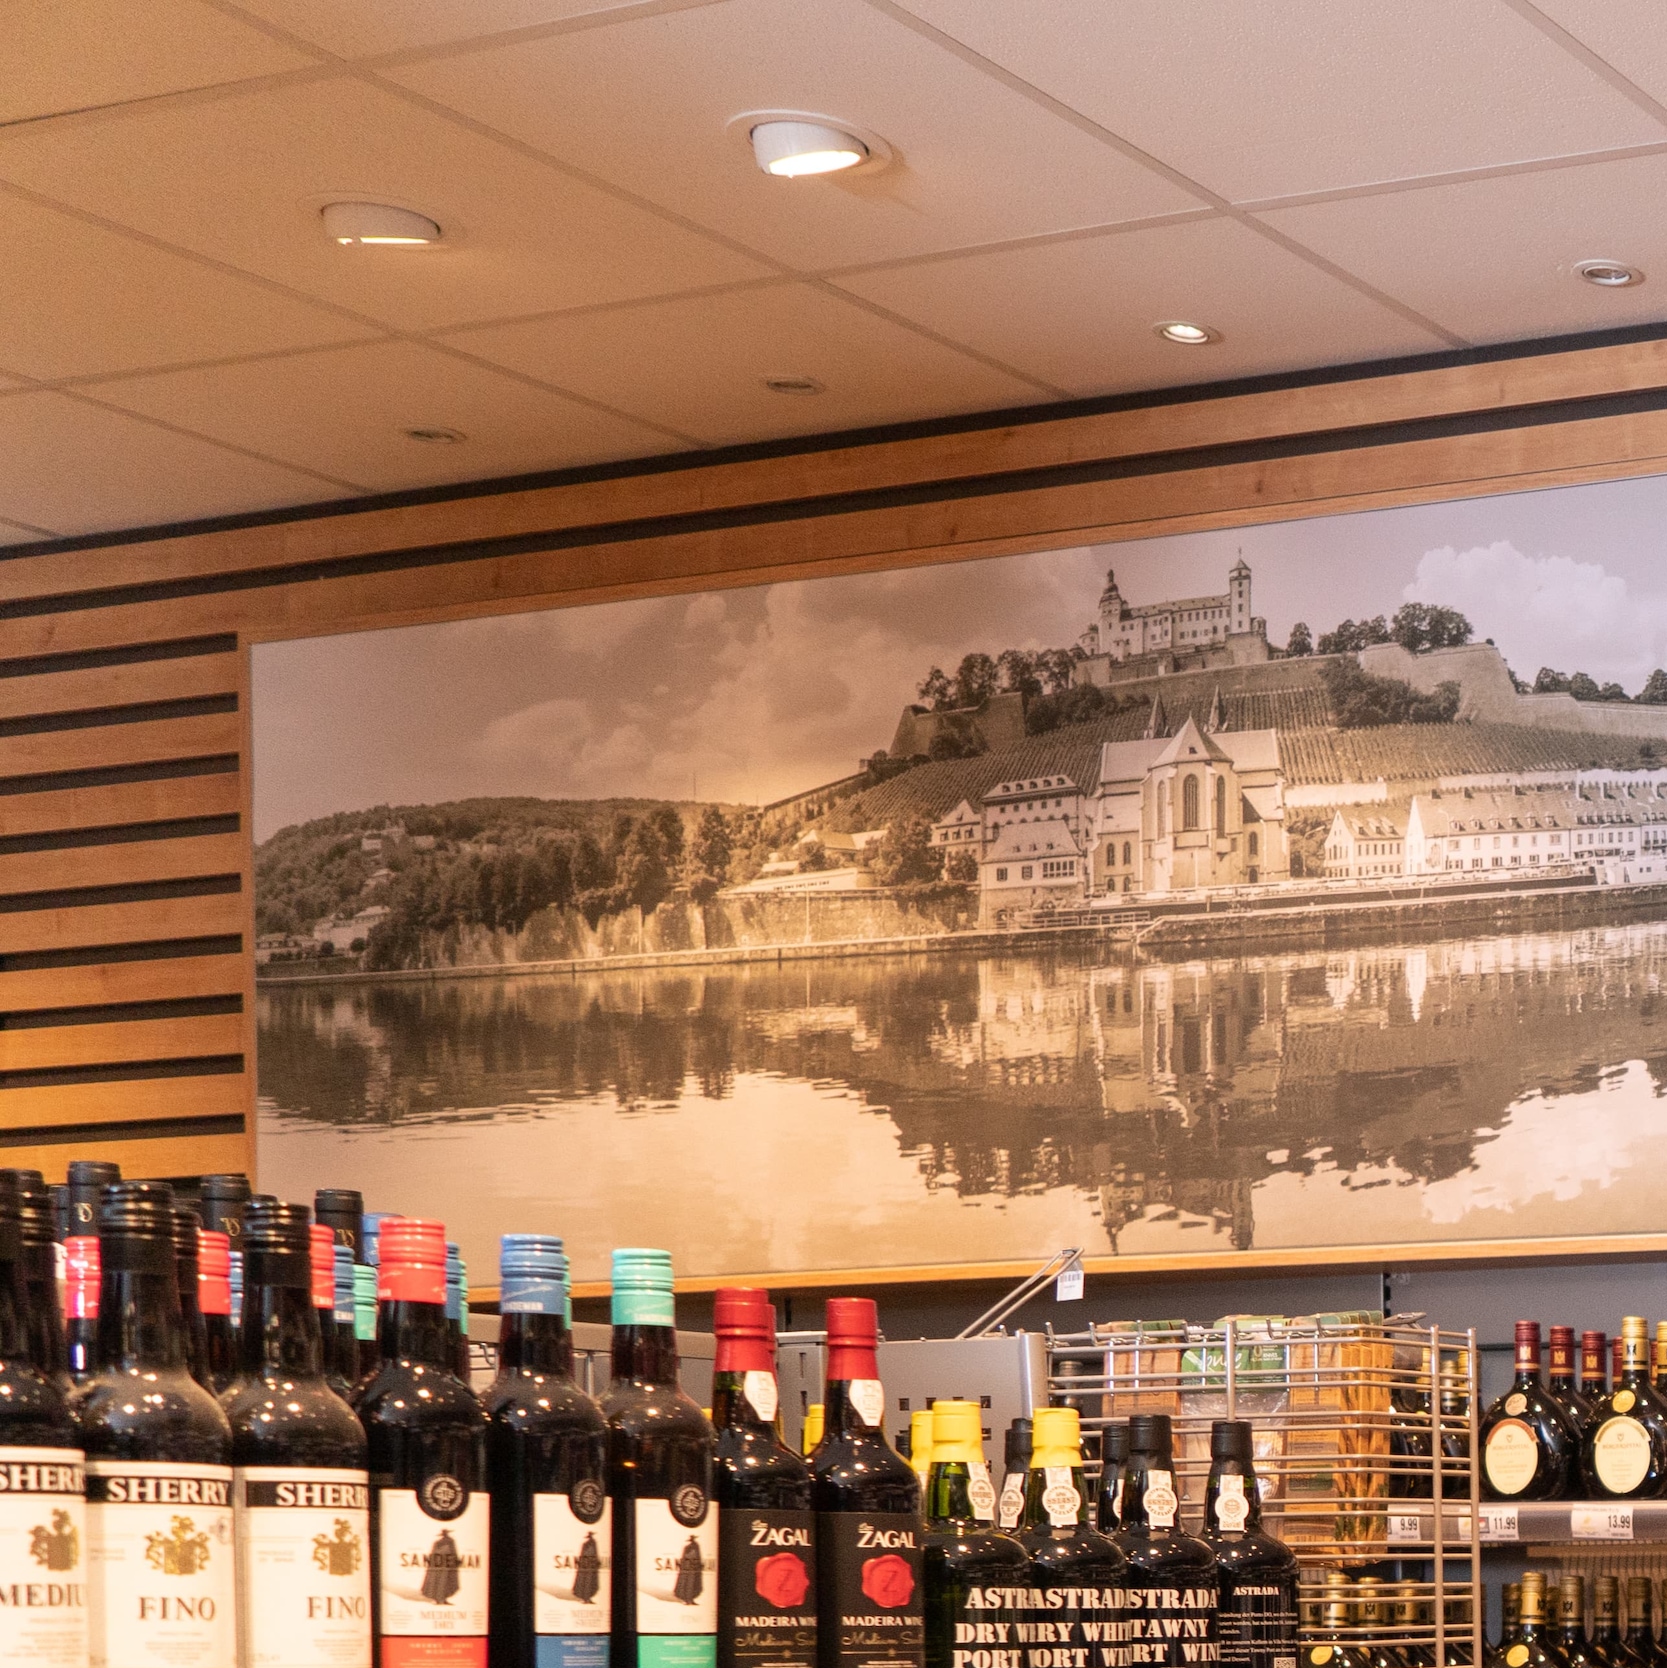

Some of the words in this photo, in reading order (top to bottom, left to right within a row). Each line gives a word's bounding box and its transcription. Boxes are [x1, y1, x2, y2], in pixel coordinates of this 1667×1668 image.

[107, 1477, 229, 1504] SHERRY
[750, 1527, 811, 1546] ZAGAL
[857, 1530, 917, 1548] ZAGAL
[400, 1552, 482, 1569] SANDEMAN
[1233, 1586, 1279, 1596] ASTRADA
[139, 1597, 216, 1621] FINO
[307, 1596, 365, 1620] FINO
[735, 1616, 798, 1627] MADEIRA
[842, 1616, 903, 1626] MADEIRA
[1131, 1618, 1209, 1639] TAWNY
[955, 1622, 1010, 1644] DRY
